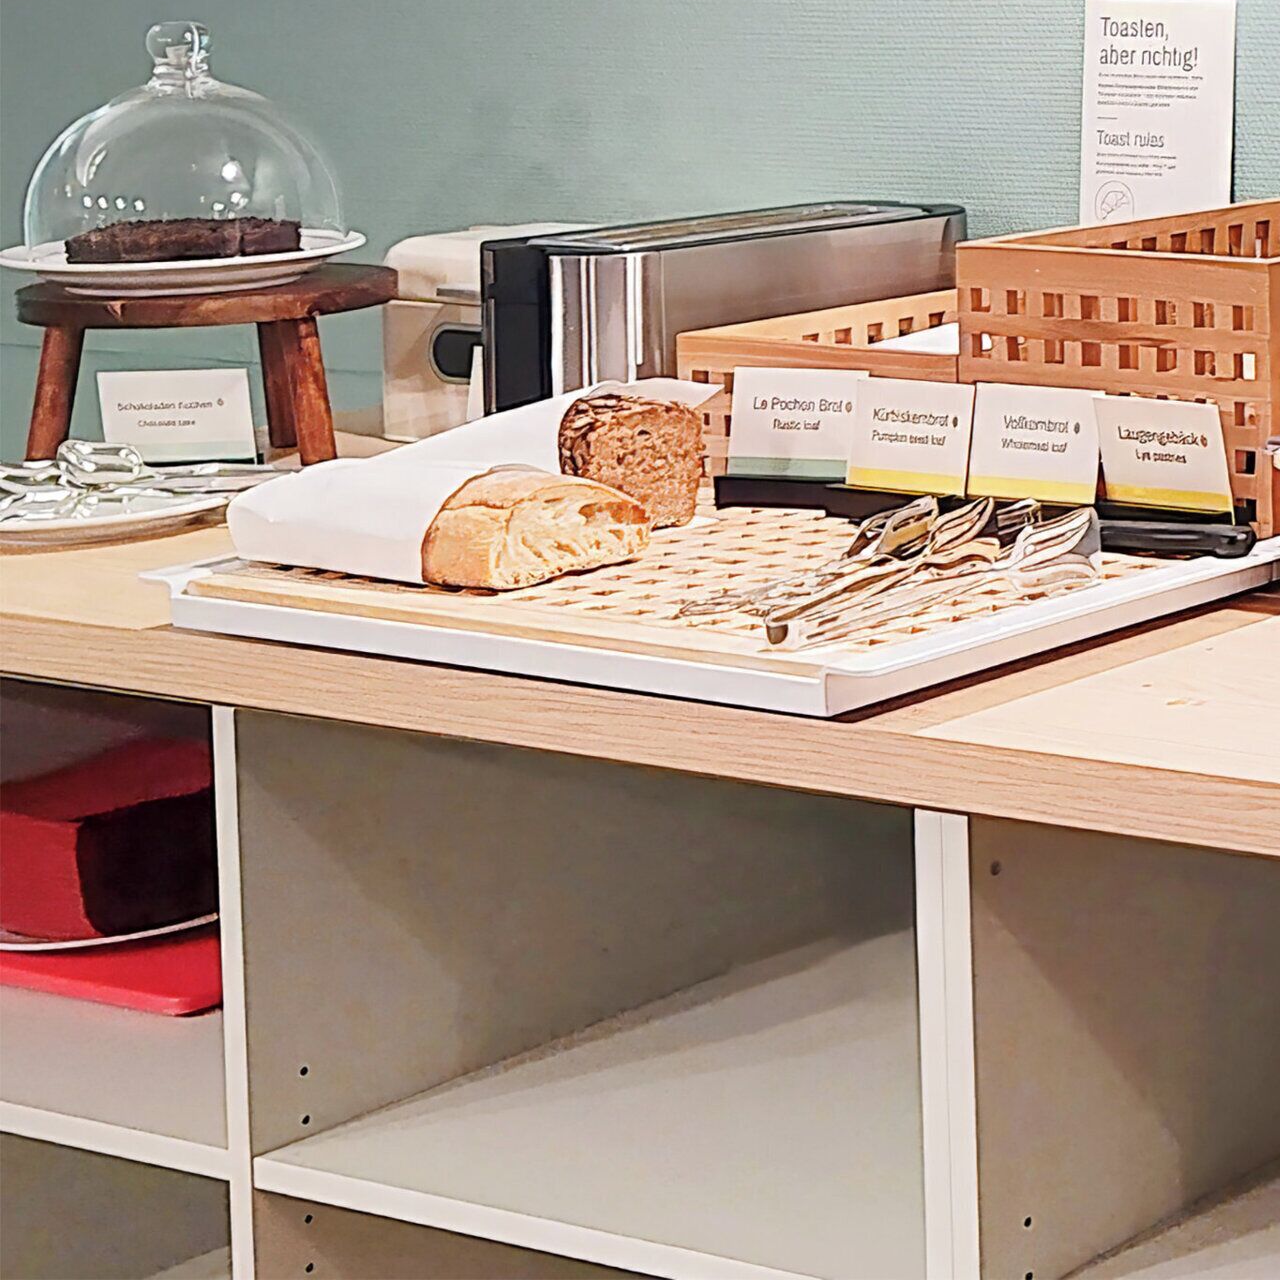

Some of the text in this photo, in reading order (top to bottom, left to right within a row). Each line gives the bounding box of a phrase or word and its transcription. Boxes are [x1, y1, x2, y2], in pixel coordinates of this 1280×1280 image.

[1100, 17, 1170, 41] Toasten,
[1099, 45, 1199, 72] aber richtig!
[1097, 130, 1165, 148] Toast rules
[819, 398, 843, 412] Brot
